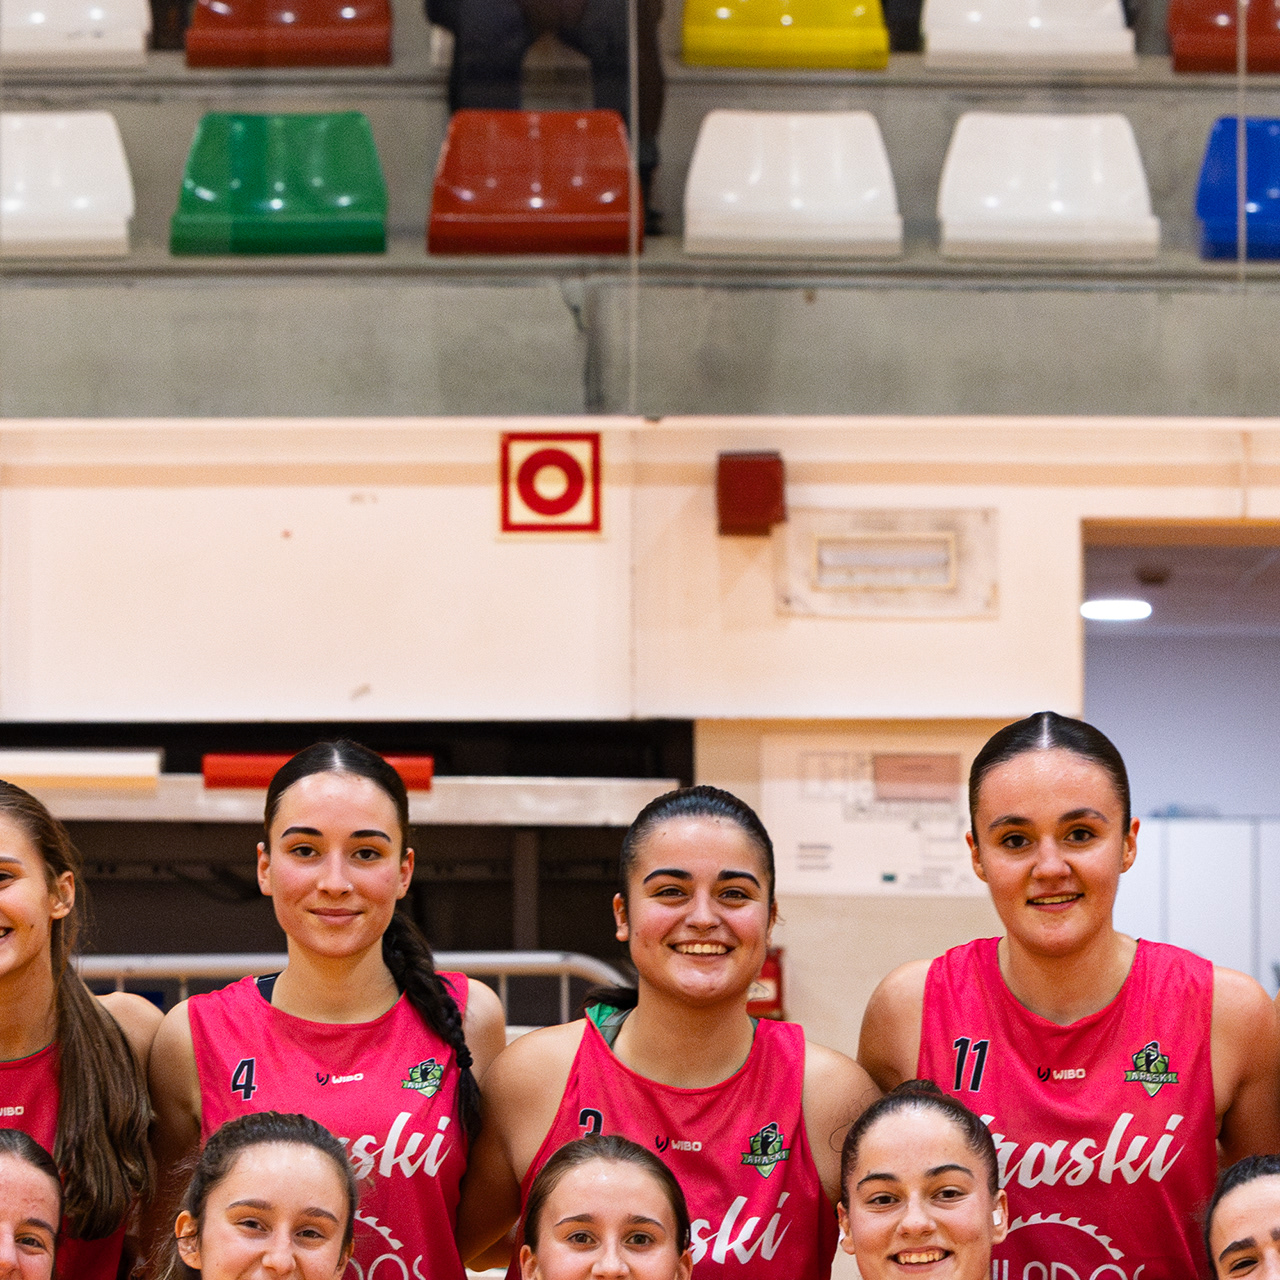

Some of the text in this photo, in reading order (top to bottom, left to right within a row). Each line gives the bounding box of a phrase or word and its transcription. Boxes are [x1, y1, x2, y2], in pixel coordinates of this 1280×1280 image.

[953, 1036, 989, 1092] 11
[1053, 1068, 1086, 1080] WIBO
[231, 1057, 257, 1101] 4
[331, 1072, 364, 1085] WIBO
[671, 1139, 702, 1151] WIBO
[980, 1112, 1184, 1189] raski
